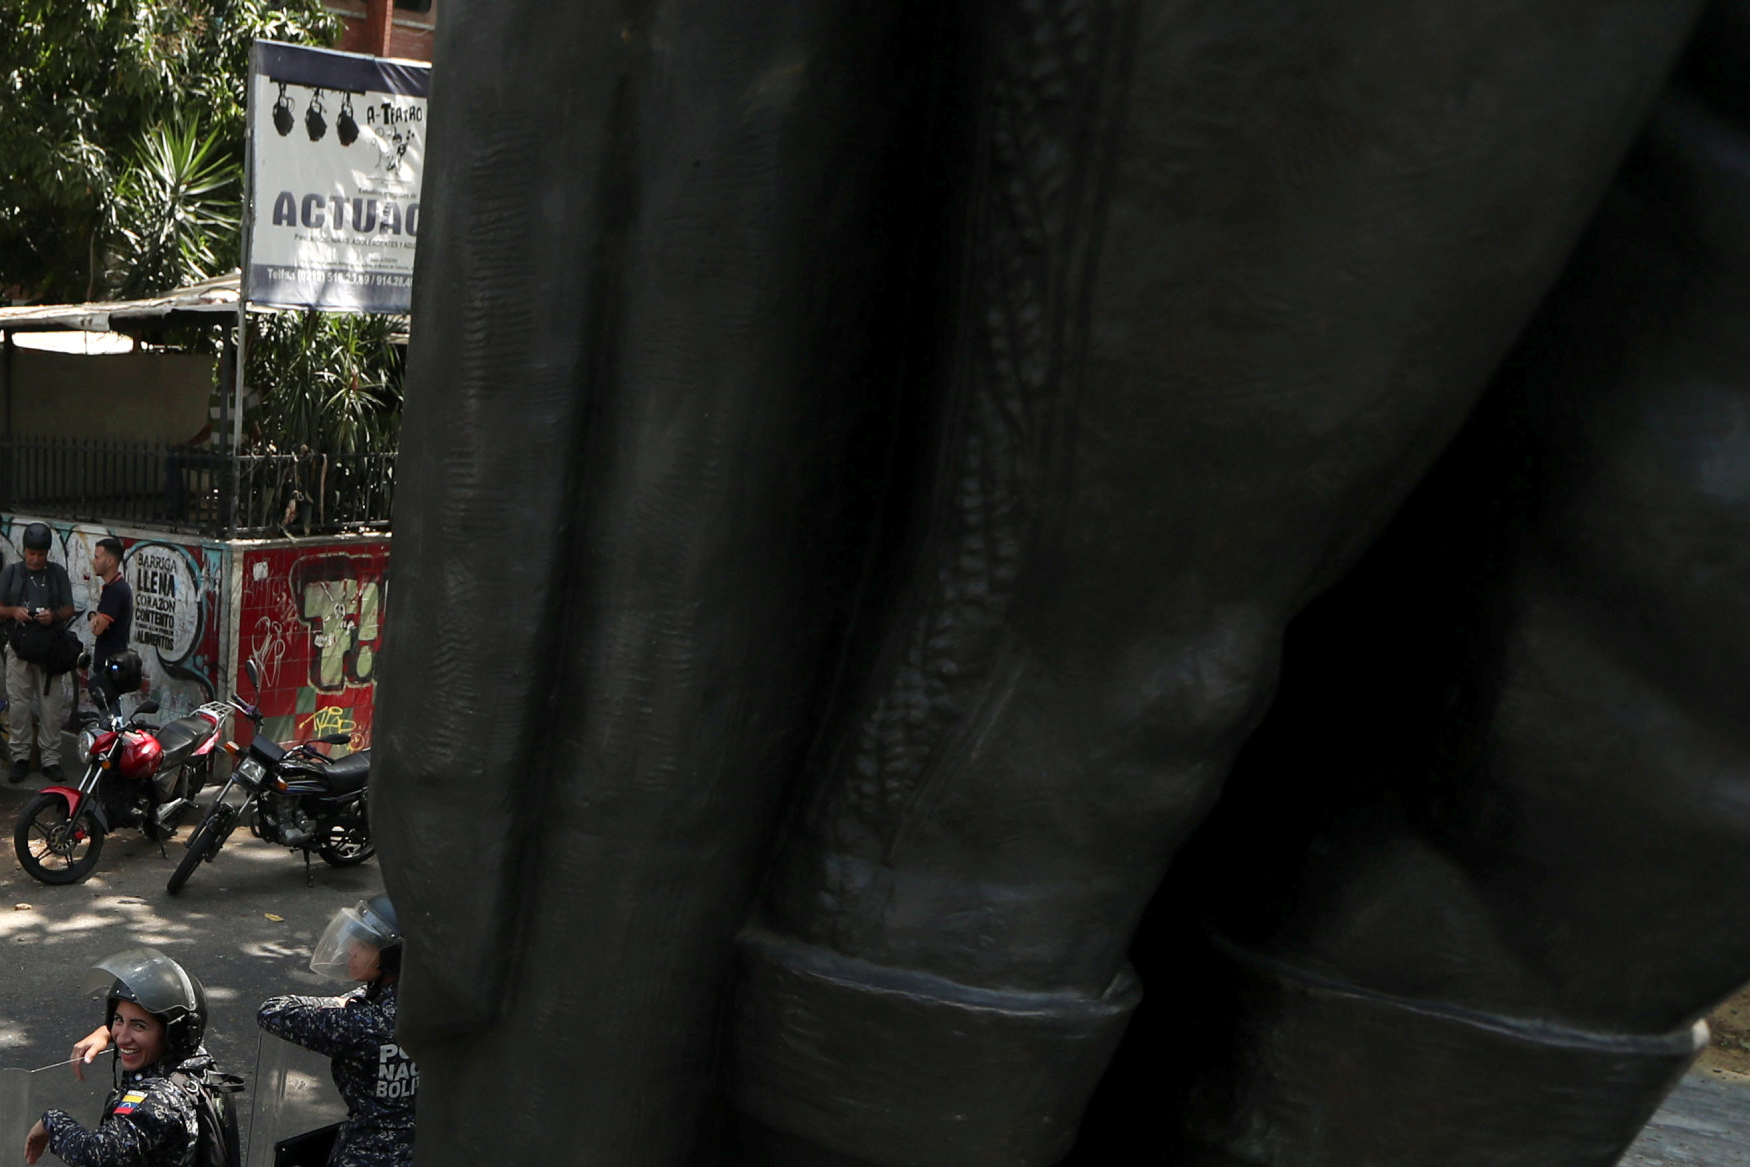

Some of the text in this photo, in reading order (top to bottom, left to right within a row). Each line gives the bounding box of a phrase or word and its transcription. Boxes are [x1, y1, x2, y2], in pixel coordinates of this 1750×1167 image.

[138, 553, 176, 573] BARRIGA
[136, 568, 175, 599] LLENA
[136, 594, 176, 613] CORAZON
[135, 608, 175, 629] CONTENTO
